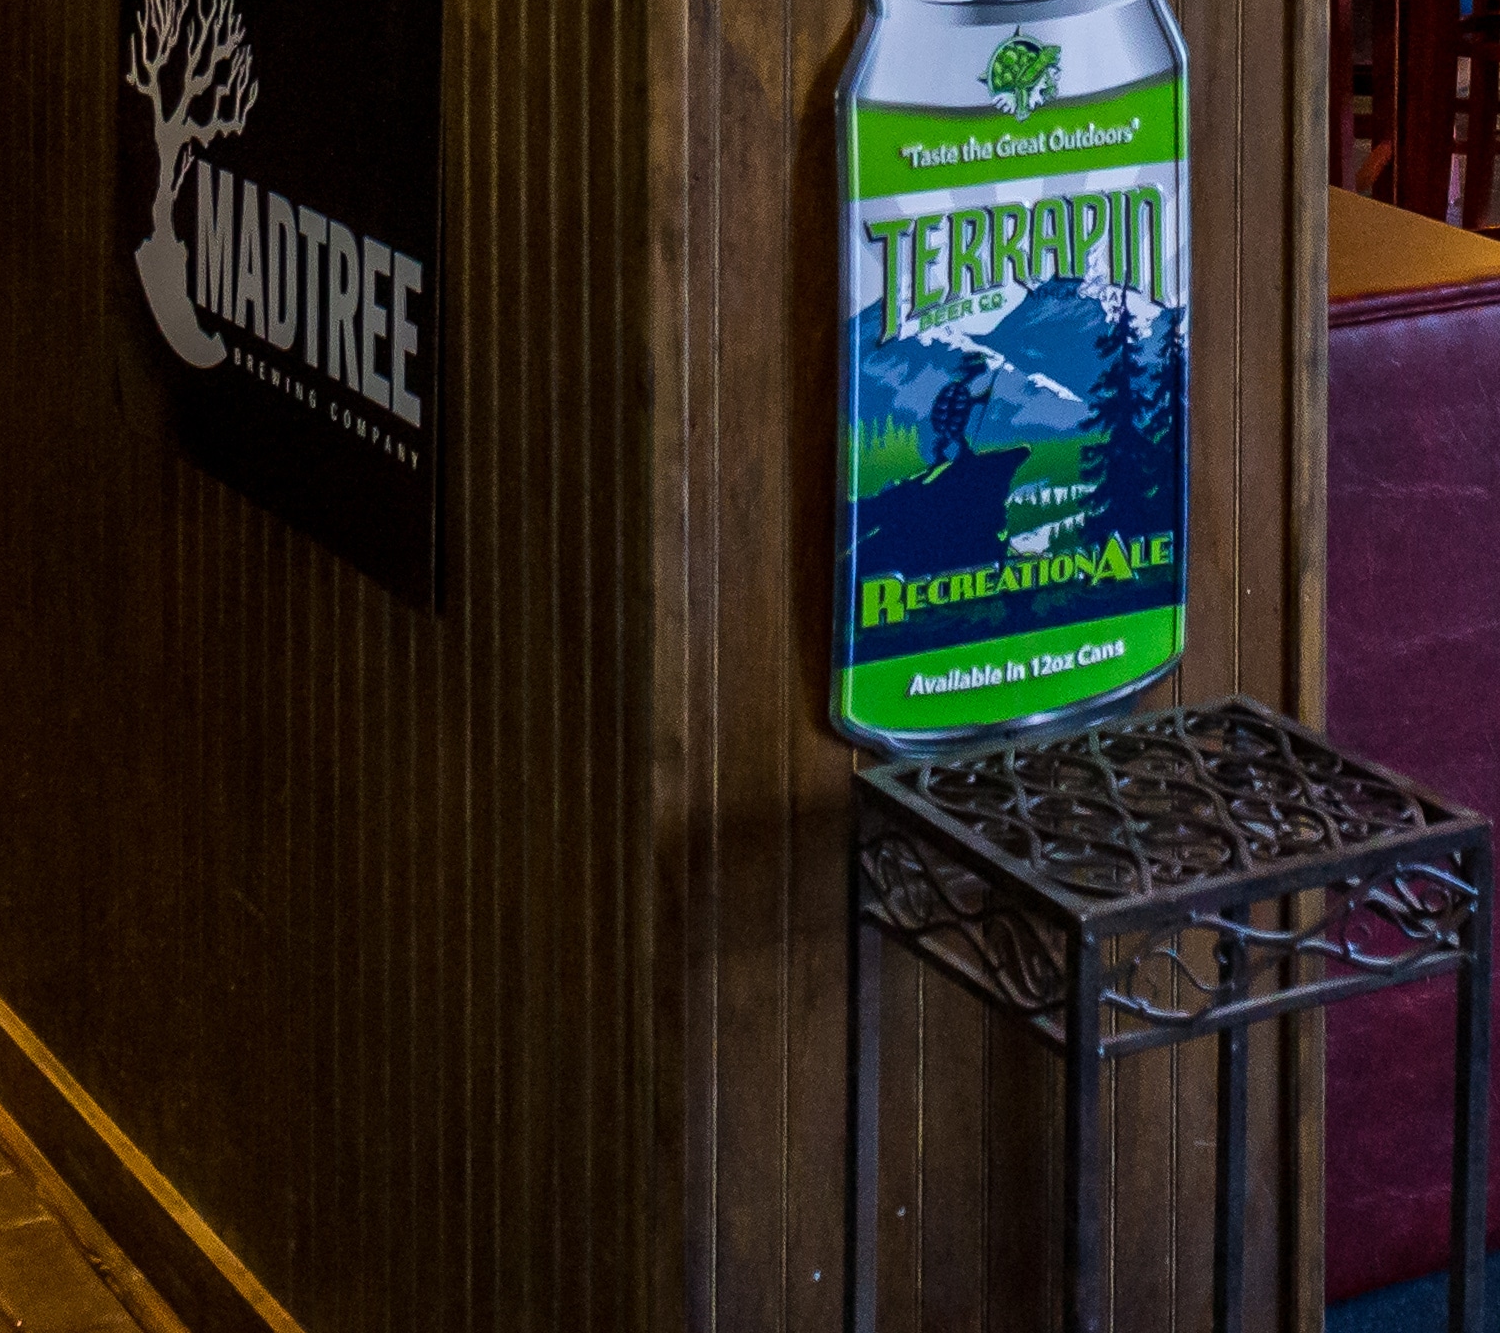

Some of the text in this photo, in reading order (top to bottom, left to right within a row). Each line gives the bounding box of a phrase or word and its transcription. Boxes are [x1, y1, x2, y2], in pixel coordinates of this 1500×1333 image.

[901, 117, 1141, 169] "Taste the Great Outdoors"
[197, 159, 423, 428] MADTREE
[863, 185, 1167, 347] TERRAPIN
[918, 300, 974, 331] BEER
[234, 347, 420, 470] BREWING COMPANY
[910, 665, 1002, 696] Available
[1030, 653, 1074, 677] 12oz
[1077, 639, 1125, 666] Cans
